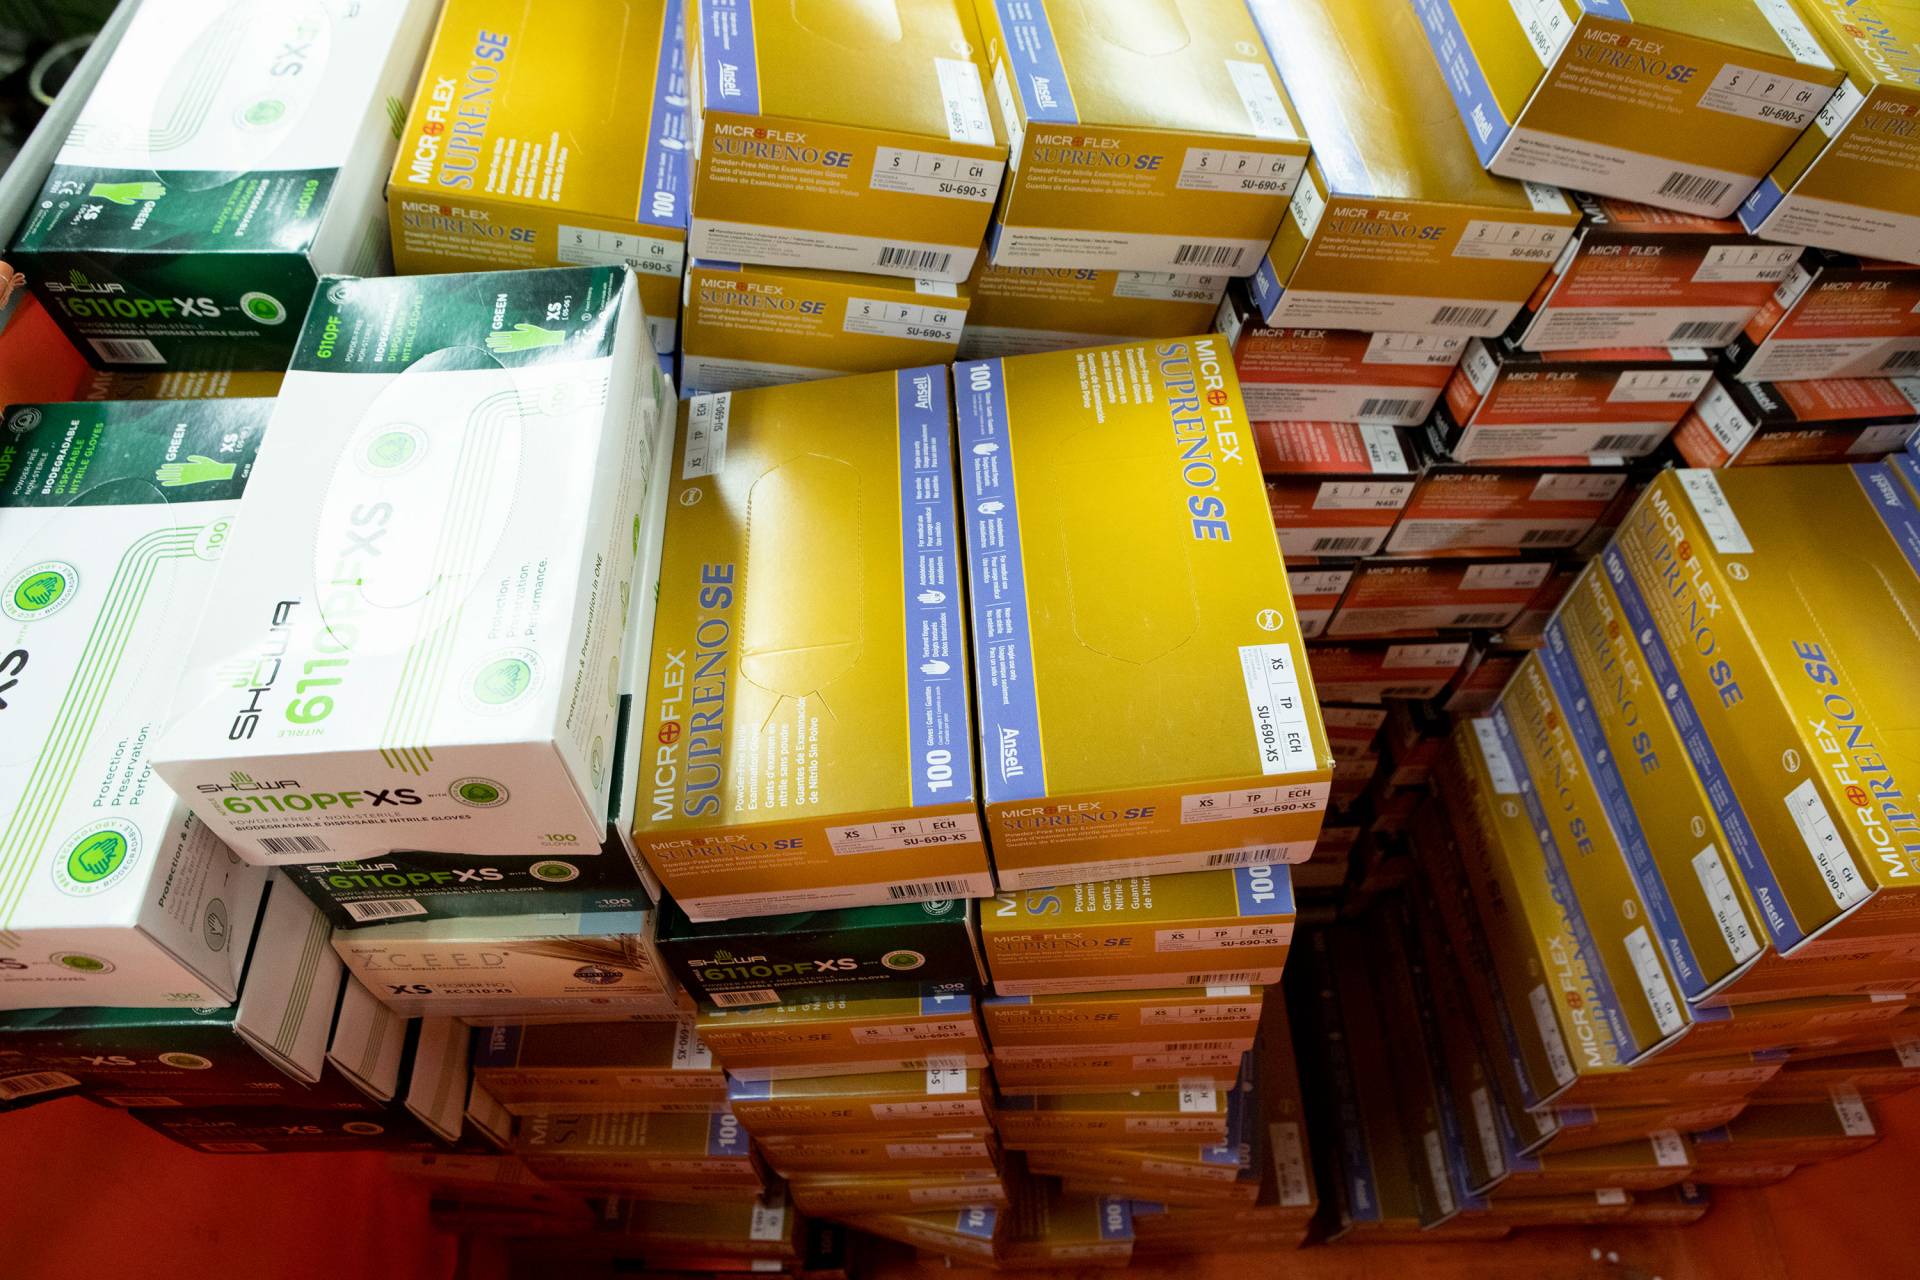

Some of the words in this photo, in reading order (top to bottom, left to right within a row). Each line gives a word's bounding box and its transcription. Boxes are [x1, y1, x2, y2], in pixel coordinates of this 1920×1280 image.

[1528, 20, 1552, 57] SU-690-S
[1573, 40, 1668, 77] SUPRENO
[1665, 63, 1698, 84] SE
[721, 62, 742, 97] Ansell
[1033, 75, 1059, 109] Ansell
[1795, 89, 1812, 105] CH
[438, 64, 500, 191] SUPRENO
[475, 30, 510, 63] SE
[1472, 103, 1495, 144] Ansell
[1757, 104, 1806, 125] SU-690-S
[711, 137, 819, 164] SUPRENO
[821, 151, 854, 168] SE
[711, 157, 757, 168] Powder-Free
[1031, 148, 1132, 169] SUPRENO
[1133, 154, 1164, 171] SE
[968, 166, 984, 178] CH
[1270, 162, 1286, 173] CH
[938, 183, 988, 198] SU-690-S
[1240, 178, 1288, 192] SU-690-S
[131, 201, 156, 230] GREEN
[651, 190, 676, 218] 100
[402, 214, 505, 238] SUPRENO
[508, 227, 537, 243] SE
[1327, 219, 1417, 239] SUPRENO
[1417, 225, 1447, 241] SE
[1540, 232, 1556, 242] CH
[651, 244, 665, 256] CH
[1509, 247, 1553, 259] SU-690-S
[1776, 252, 1793, 263] CH
[44, 282, 127, 295] SHOWA
[1171, 288, 1215, 301] SU-690-S
[492, 293, 508, 331] GREEN
[546, 302, 562, 322] XS
[699, 290, 796, 312] SUPRENO
[798, 300, 827, 315] SE
[933, 313, 948, 324] CH
[316, 315, 343, 359] 6110PF
[905, 327, 952, 339] SU-690-S
[1443, 339, 1459, 348] CH
[969, 363, 992, 392] 100
[1686, 376, 1701, 385] CH
[912, 375, 929, 409] Ansell
[713, 396, 727, 432] SU-690-XS
[1729, 417, 1742, 432] CH
[165, 423, 188, 462] GREEN
[219, 432, 239, 454] XS
[1155, 342, 1218, 489] SUPRENO
[1187, 495, 1232, 542] SE
[41, 419, 80, 496] BIODEGRADABLE
[55, 438, 86, 495] DISPOSABLE
[68, 456, 89, 495] NITRILE
[84, 421, 105, 457] GLOVES
[12, 446, 40, 496] POWDER-FREE
[24, 452, 49, 497] NON-STERILE
[1870, 473, 1901, 508] Ansell
[525, 556, 549, 638] Performance.
[699, 563, 735, 610] SE
[920, 619, 930, 638] fingers
[921, 638, 931, 658] Textured
[931, 640, 940, 658] Doigts
[941, 642, 950, 658] Dedos
[1007, 644, 1017, 660] Single
[1791, 639, 1840, 687] SE
[925, 686, 933, 707] Guantes
[1707, 659, 1744, 709] SE
[564, 672, 583, 731] Protection
[1270, 657, 1284, 671] XS
[1279, 695, 1293, 710] TP
[1287, 731, 1303, 755] ECH
[683, 618, 730, 818] SUPRENO
[808, 716, 819, 743] Polvo
[1256, 704, 1280, 764] SU-690-XS
[111, 721, 153, 807] Preservation.
[766, 735, 777, 779] d'examen
[1002, 727, 1024, 779] Ansell
[1632, 731, 1661, 776] SE
[93, 736, 130, 808] Protection.
[748, 753, 760, 811] Examination
[809, 759, 819, 790] Nitrilo
[926, 749, 953, 793] 100
[197, 780, 301, 793] SHOWA
[765, 780, 776, 809] Gants
[779, 777, 789, 808] nitrile
[795, 766, 806, 806] Guantes
[1199, 799, 1215, 809] XS
[1246, 794, 1262, 804] TP
[1287, 789, 1312, 800] ECH
[229, 815, 312, 826] POWDER-FREE
[326, 811, 401, 821] NON-STERILE
[1003, 810, 1119, 832] SUPRENO
[1122, 806, 1157, 821] SE
[1252, 801, 1317, 816] SU-690-XS
[235, 820, 323, 832] BIODEGRADABLE
[324, 818, 388, 828] DISPOSABLE
[389, 816, 430, 825] NITRILE
[431, 814, 472, 822] GLOVES
[844, 829, 861, 840] XS
[891, 825, 907, 835] TP
[932, 820, 957, 831] ECH
[655, 840, 769, 862] SUPRENO
[773, 838, 804, 851] SE
[903, 831, 968, 847] SU-690-XS
[158, 840, 184, 908] Protection
[306, 863, 399, 874] SHOWA
[1816, 852, 1846, 901] SU-690-S
[1841, 867, 1855, 883] CH
[413, 890, 465, 899] DISPOSABLE
[1249, 864, 1275, 905] 100
[1757, 886, 1786, 932] Ansell
[1102, 937, 1134, 947] SE
[1170, 932, 1185, 940] XS
[1213, 930, 1229, 938] TP
[1251, 927, 1274, 936] ECH
[1219, 938, 1279, 948] SU-690-XS
[688, 954, 768, 967] SHOWA
[1669, 937, 1694, 980] Ansell
[387, 983, 433, 996] XS
[1092, 1012, 1122, 1022] SE
[1226, 1006, 1248, 1014] ECH
[807, 1032, 833, 1042] SE
[937, 1023, 958, 1031] ECH
[1608, 1008, 1629, 1047] Ansell
[719, 1114, 738, 1148] 100
